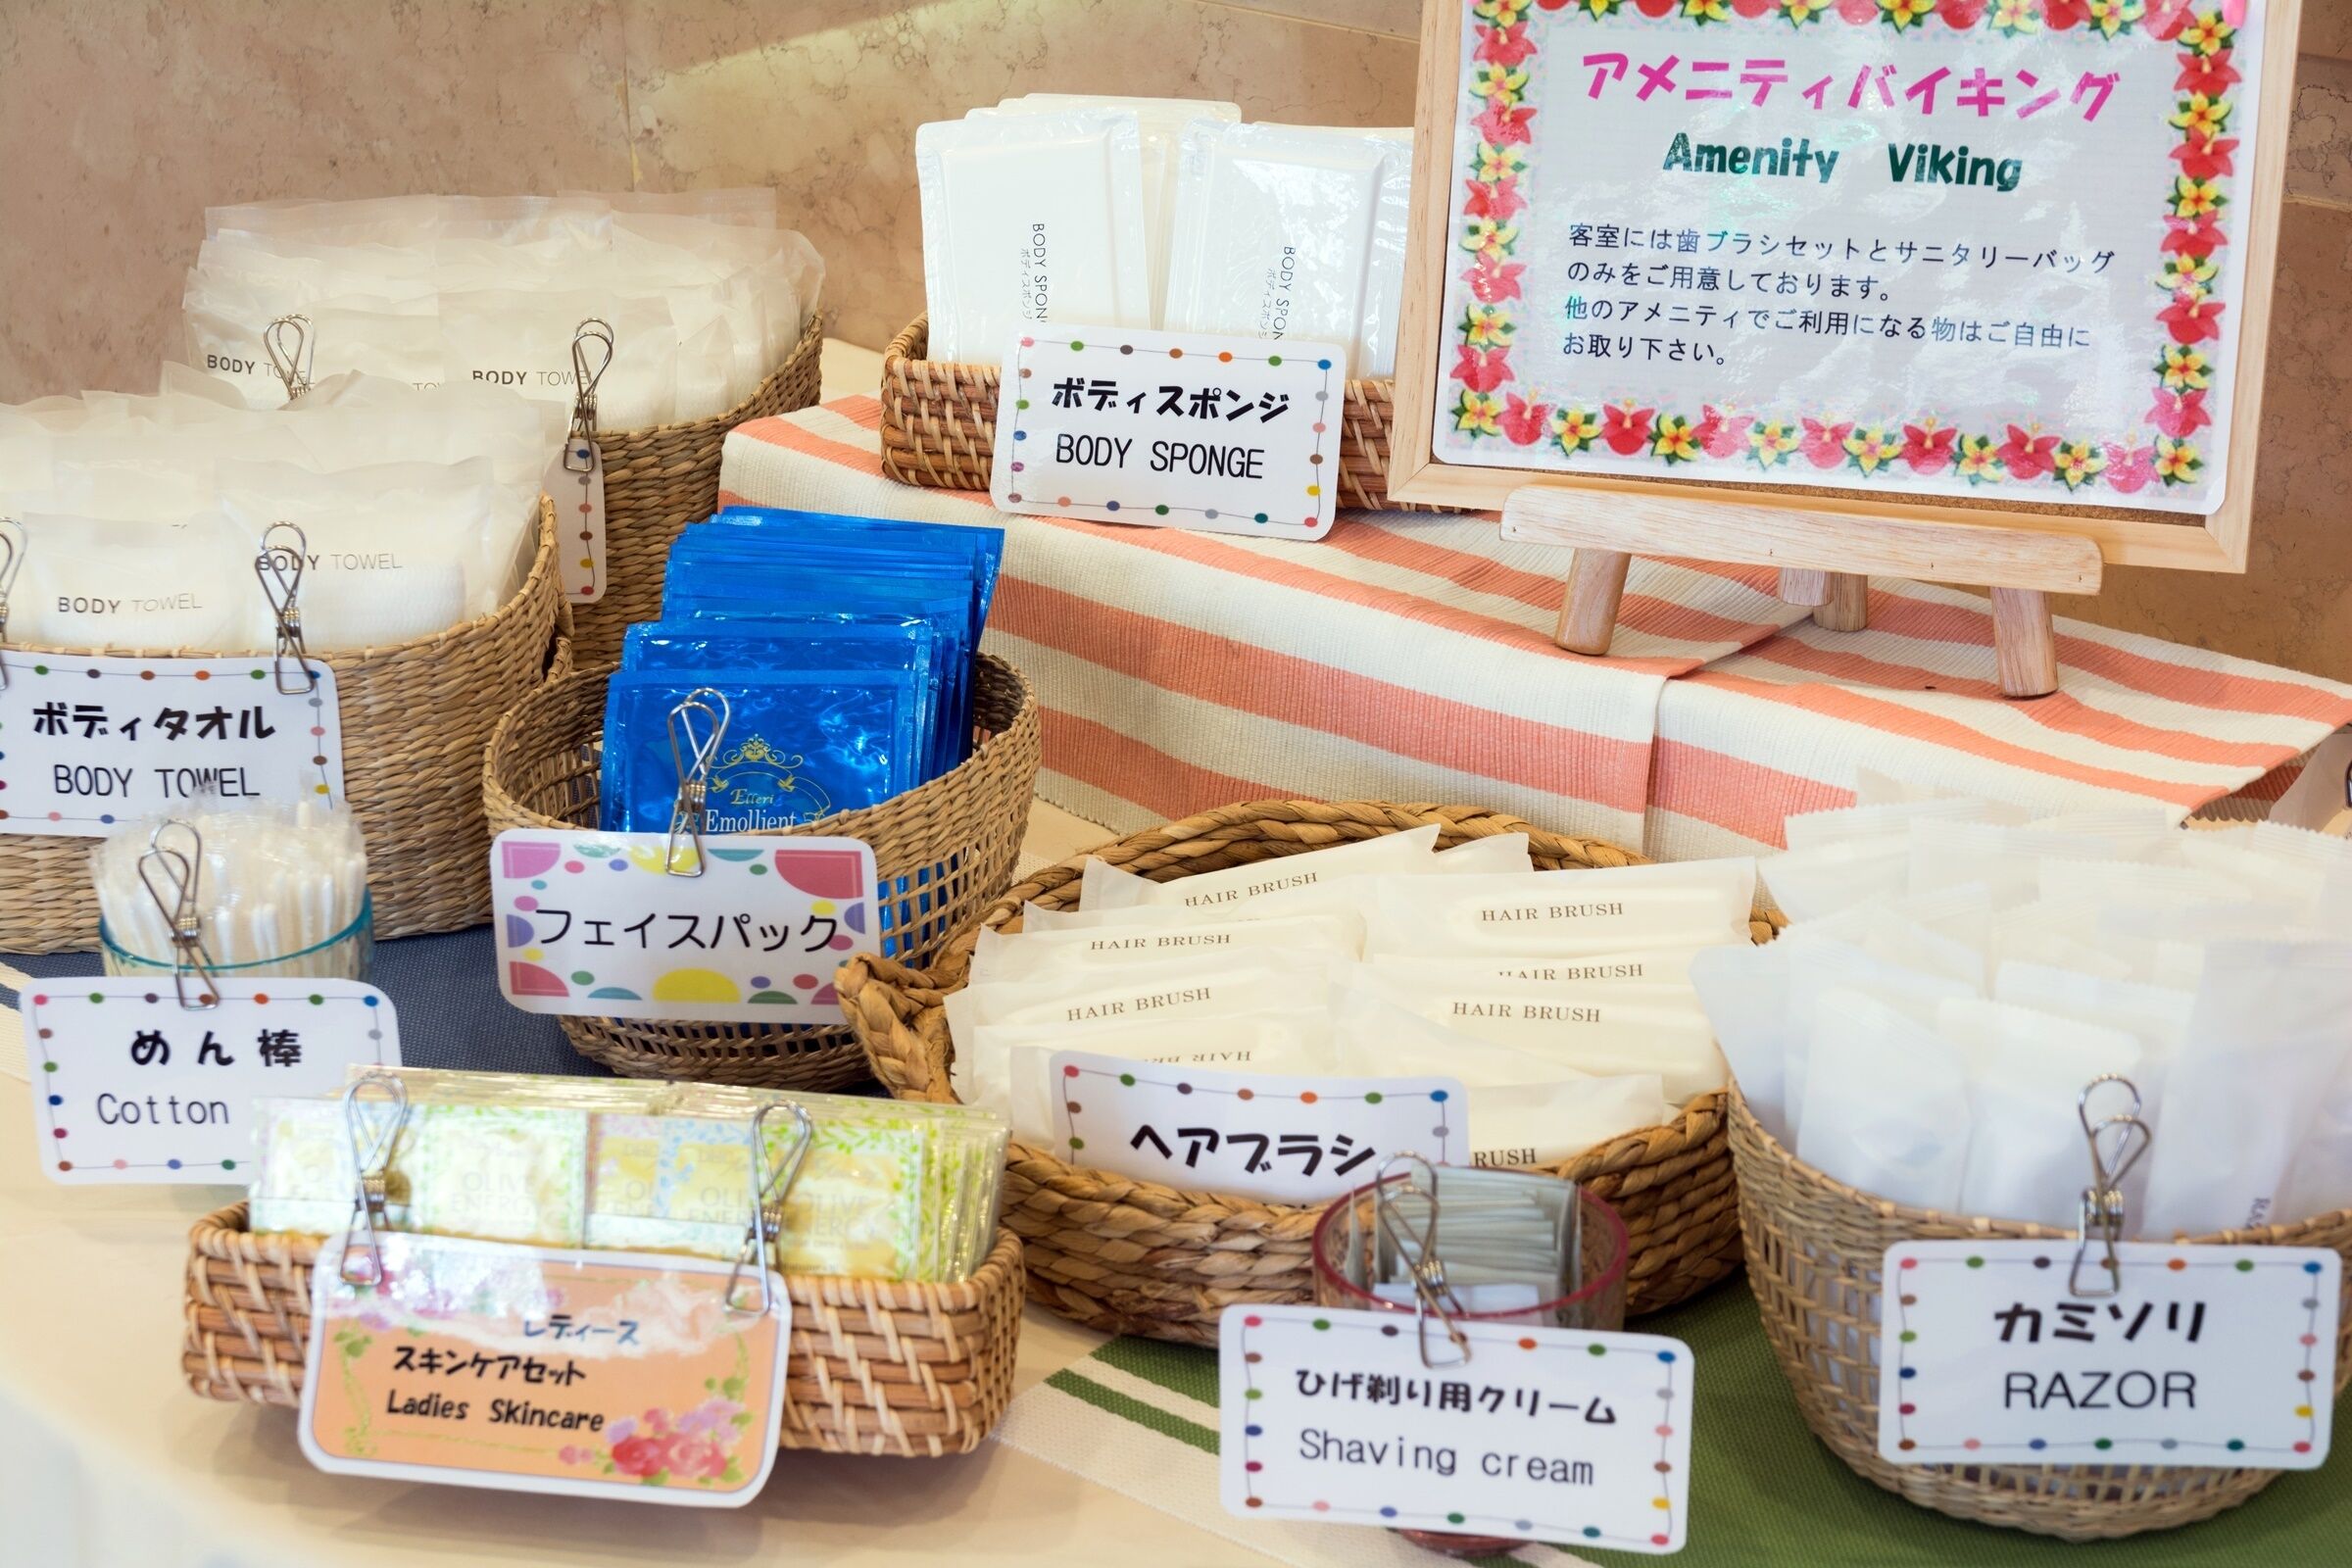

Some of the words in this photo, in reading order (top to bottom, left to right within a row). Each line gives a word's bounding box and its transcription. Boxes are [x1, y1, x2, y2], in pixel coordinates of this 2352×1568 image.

[1582, 51, 2121, 122] アメニティバイキング
[1662, 131, 1839, 184] Amenity
[1887, 142, 2024, 192] Viking
[1032, 222, 1047, 268] BODY
[1568, 221, 2115, 274] 客室には歯ブラシセットとサニタリーバッグ
[1279, 246, 1296, 292] BODY
[1567, 262, 1888, 302] のみをご用意しております。
[1034, 274, 1049, 323] SPON
[1564, 294, 2090, 348] 他のアメニティでご利用になる物はご自由に
[207, 354, 256, 375] BODY
[1562, 331, 1726, 367] お取り下さい。
[1052, 377, 1290, 424] ボディスポンジ
[1055, 433, 1133, 469] BODY
[1150, 440, 1264, 480] SPONGE
[330, 554, 403, 570] TOWEL
[58, 597, 122, 614] BODY
[131, 594, 203, 612] TOWEL
[32, 701, 276, 742] ボディタオル
[54, 763, 133, 799] BODY
[154, 766, 262, 799] TOWEL
[730, 788, 775, 806] Elleri
[705, 808, 796, 833] Emollient
[1184, 890, 1239, 907] HAIR
[1248, 872, 1319, 898] BRUSH
[534, 907, 838, 953] フェイスパック
[1482, 907, 1539, 922] HAIR
[1548, 903, 1624, 919] BRUSH
[1090, 937, 1147, 951] HAIR
[1156, 934, 1232, 948] BRUSH
[1498, 968, 1556, 981] AIR
[1567, 963, 1643, 980] BRUSH
[1066, 1001, 1126, 1022] HAIR
[1134, 987, 1212, 1011] BRUSH
[1452, 1002, 1512, 1018] HAIR
[1523, 1004, 1601, 1023] BRUSH
[96, 1093, 230, 1125] Cotton
[1130, 1124, 1377, 1177] ヘアブラシ
[524, 1314, 640, 1346] レディース
[1993, 1300, 2206, 1344] カミソリ
[393, 1346, 587, 1387] スキンケアセット
[386, 1388, 470, 1420] Ladies
[488, 1397, 606, 1433] Skincare
[1295, 1370, 1617, 1426] ひげ剃り用クリーム
[2004, 1370, 2198, 1411] RAZOR
[1298, 1427, 1457, 1476] Shaving
[1481, 1450, 1594, 1487] cream
